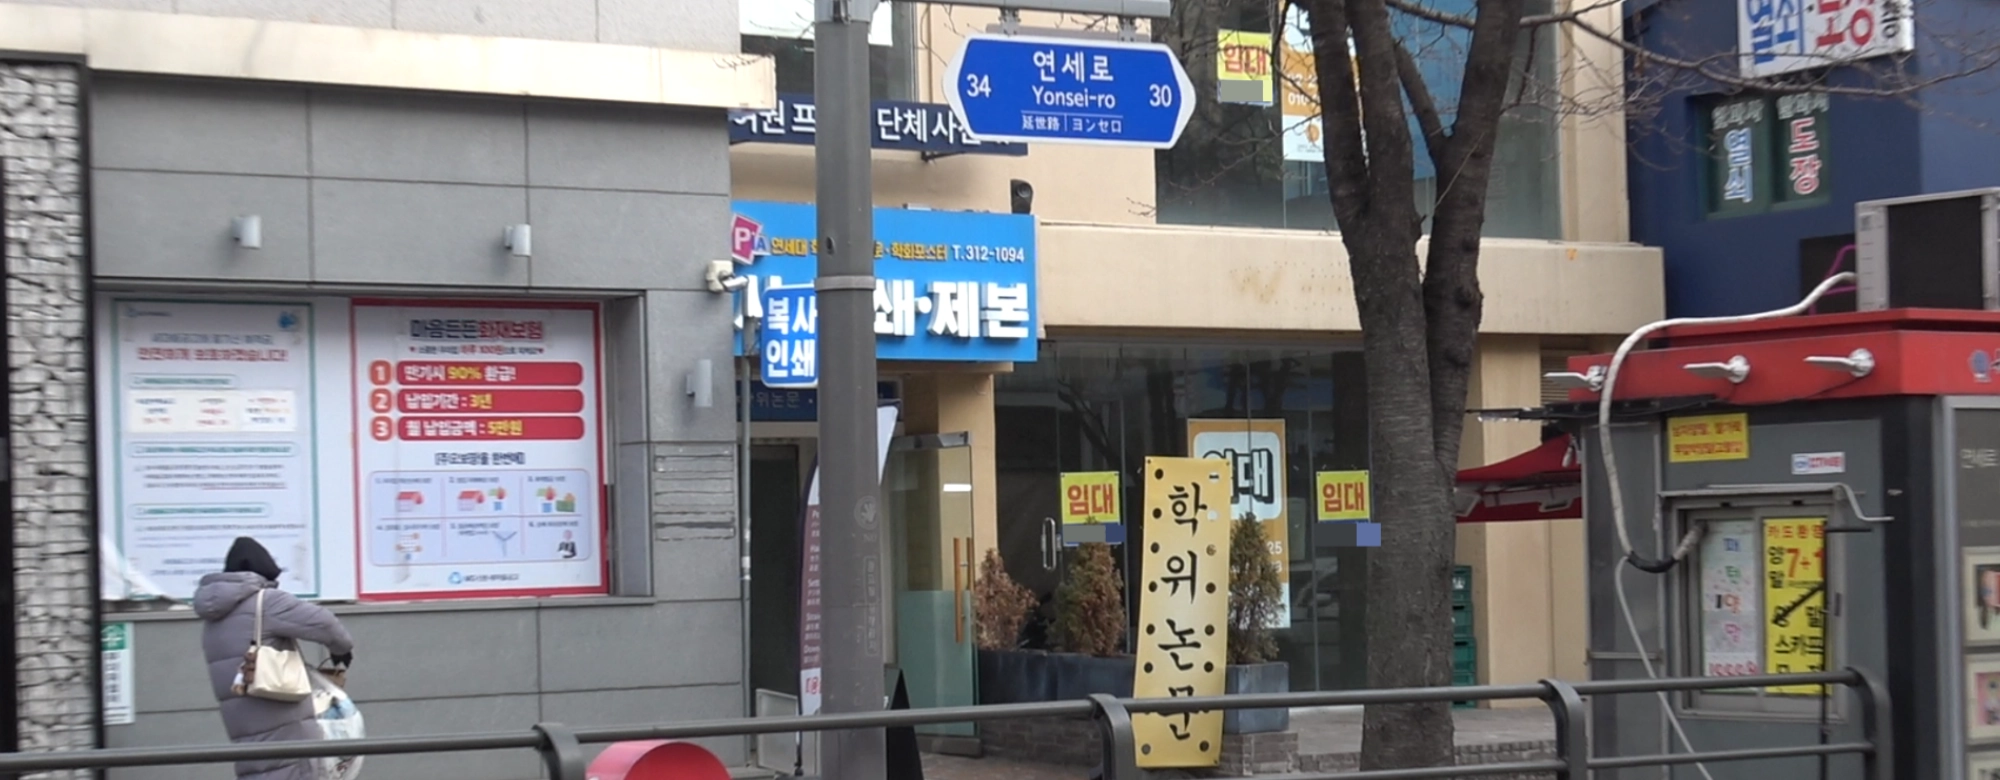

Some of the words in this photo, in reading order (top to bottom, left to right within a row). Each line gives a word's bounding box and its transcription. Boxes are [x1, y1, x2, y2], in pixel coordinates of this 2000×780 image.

[1033, 50, 1114, 83] 연세로
[1223, 43, 1267, 75] 임대
[966, 74, 991, 98] 34
[1031, 86, 1116, 109] Yonsei-ro
[1149, 84, 1172, 108] 30
[1022, 115, 1060, 131] 延世路
[1724, 127, 1752, 203] 열쇠
[1788, 117, 1822, 194] 도장
[770, 237, 807, 256] 연세대
[952, 244, 1025, 263] T.312-1094
[767, 295, 818, 335] 복사
[766, 339, 816, 378] 인쇄
[375, 367, 387, 381] 1
[447, 366, 483, 380] 90%
[375, 394, 388, 409] 2
[469, 393, 492, 410] 3년
[749, 391, 800, 408] 위논문
[375, 420, 389, 436] 3
[1067, 484, 1114, 516] 임대
[1322, 482, 1365, 513] 임대
[1768, 546, 1785, 589] 양말
